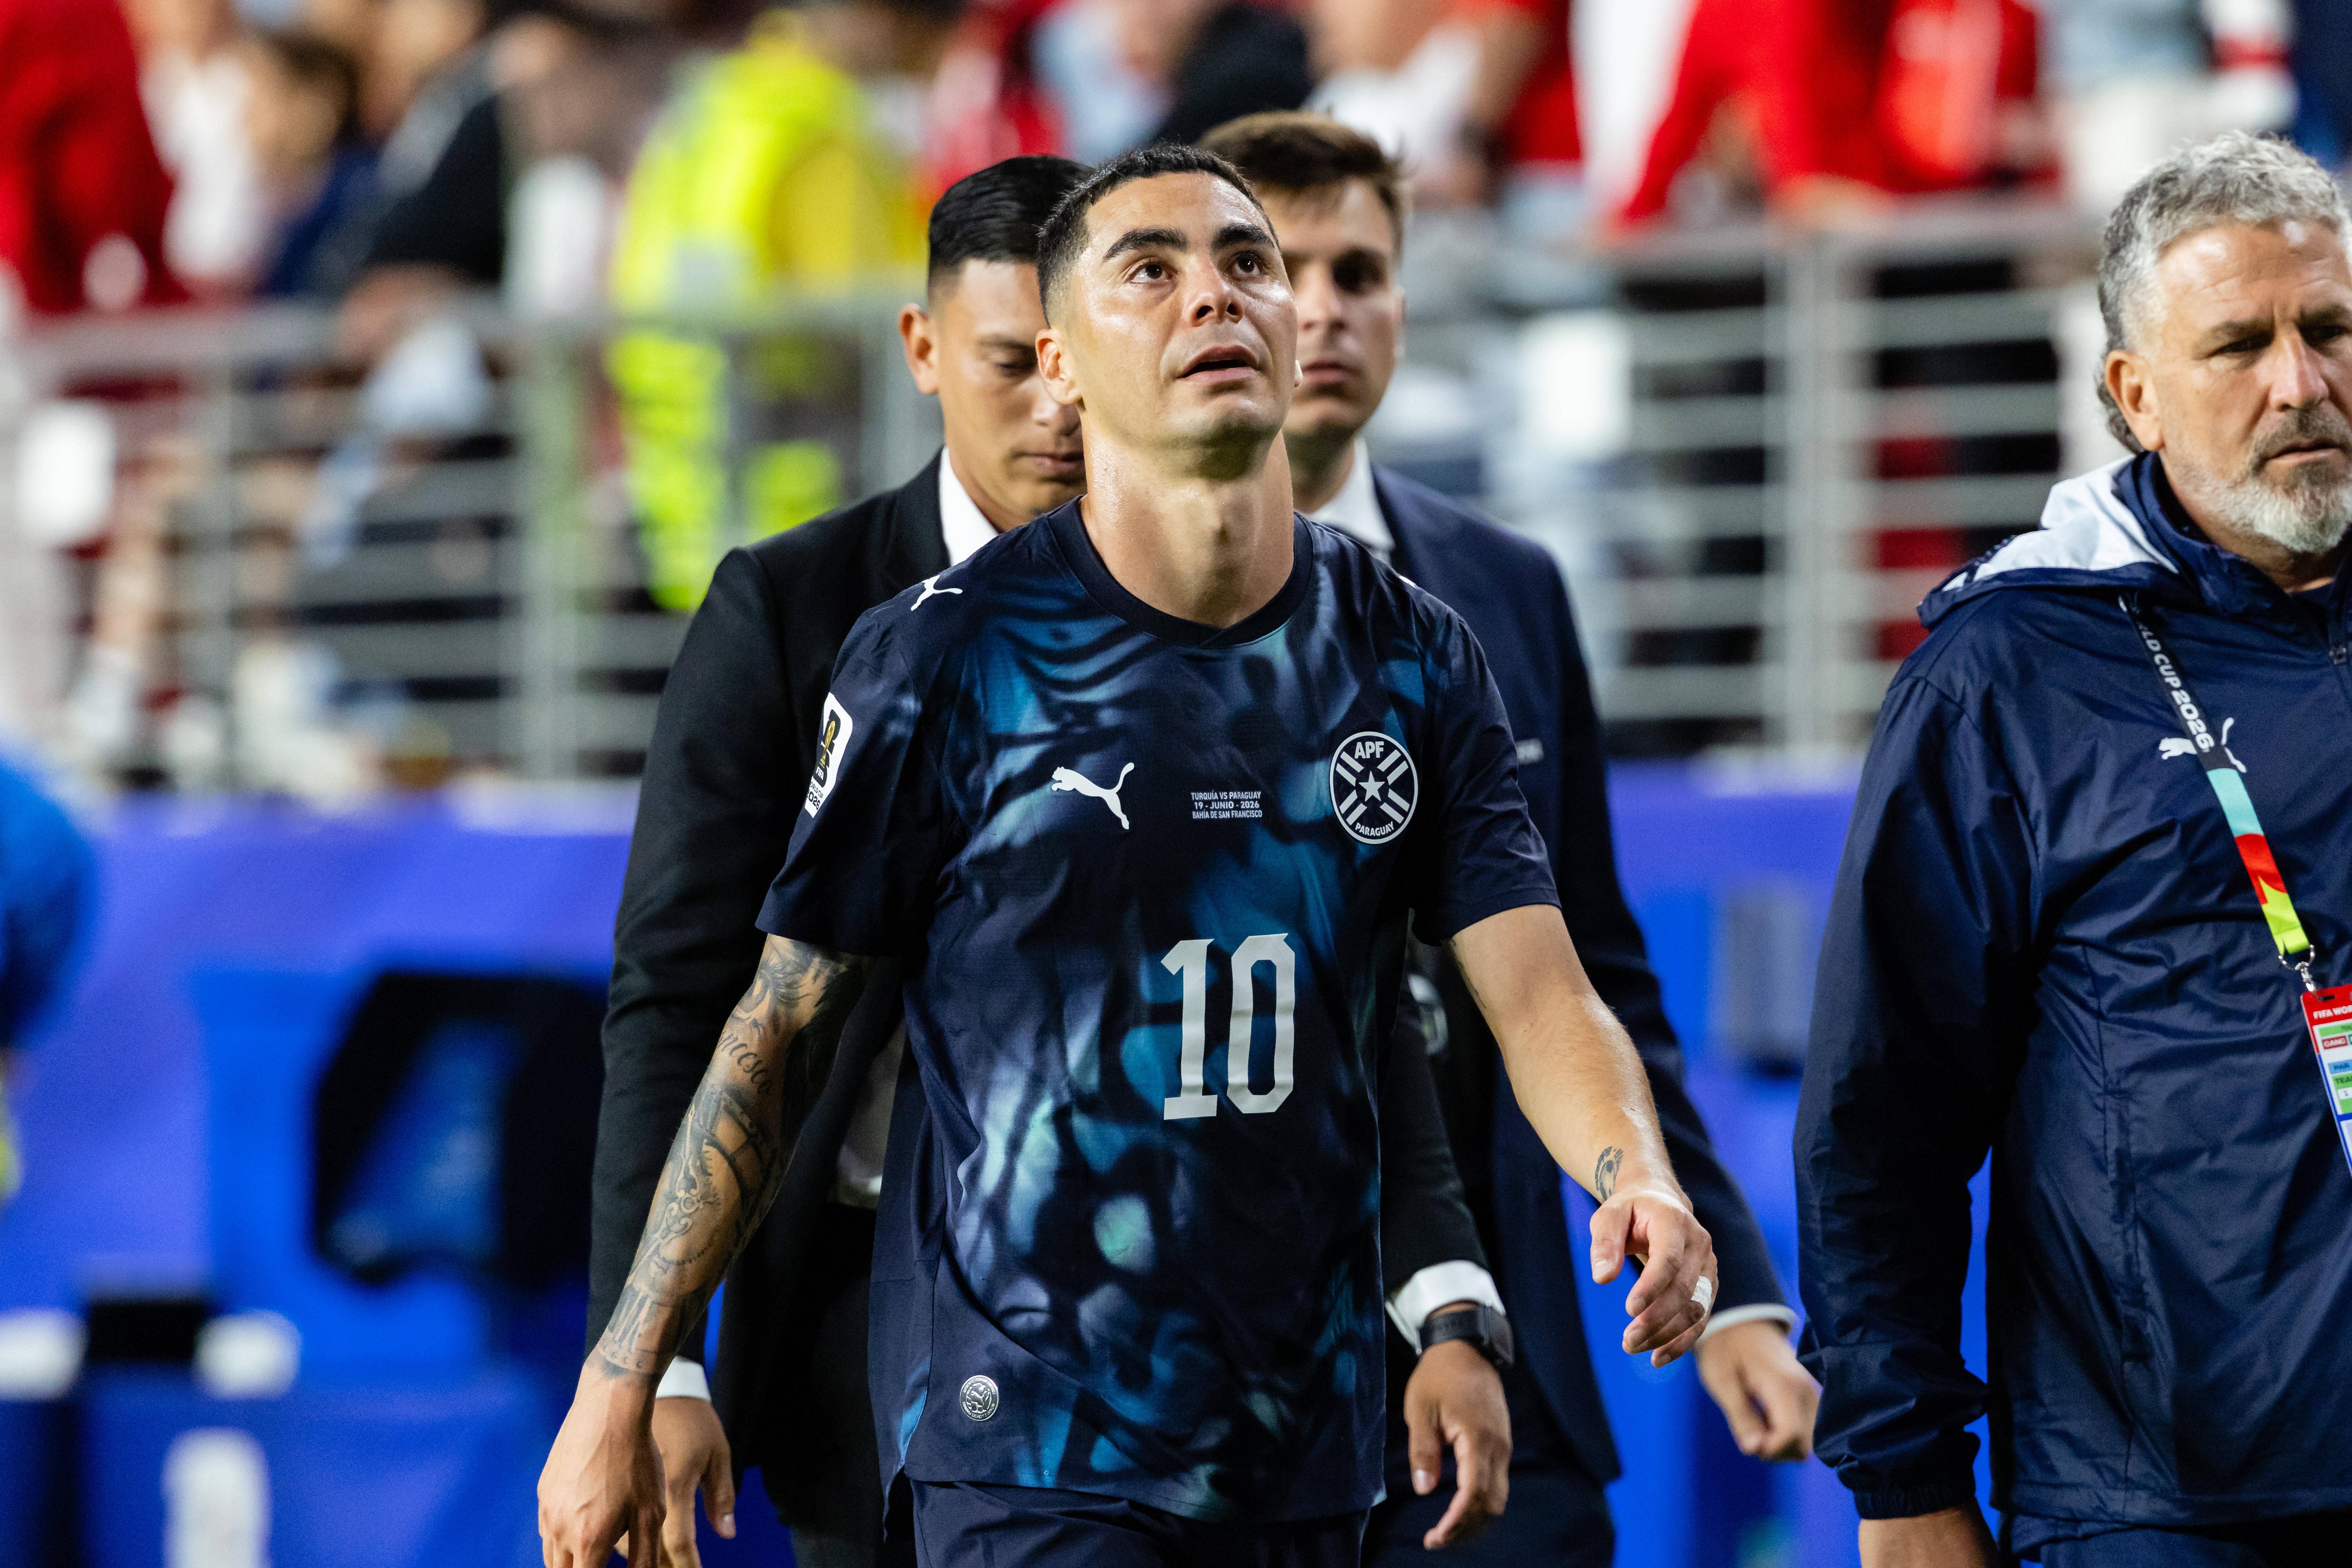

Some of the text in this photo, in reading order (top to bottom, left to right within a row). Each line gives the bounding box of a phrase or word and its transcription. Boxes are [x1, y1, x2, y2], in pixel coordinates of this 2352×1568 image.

[2155, 654, 2181, 688] CUP
[2171, 689, 2214, 751] 2026
[1355, 741, 1384, 759] APF
[816, 766, 824, 780] FIFA
[810, 782, 818, 793] ORLD
[1191, 790, 1218, 800] TURQUÍA
[806, 791, 820, 810] 026
[1192, 810, 1210, 819] BAHÍA
[1231, 810, 1262, 818] FRANCISCO
[1355, 821, 1394, 837] PARAGUAY
[2313, 1009, 2333, 1019] FIFA
[1160, 933, 1295, 1120] 10
